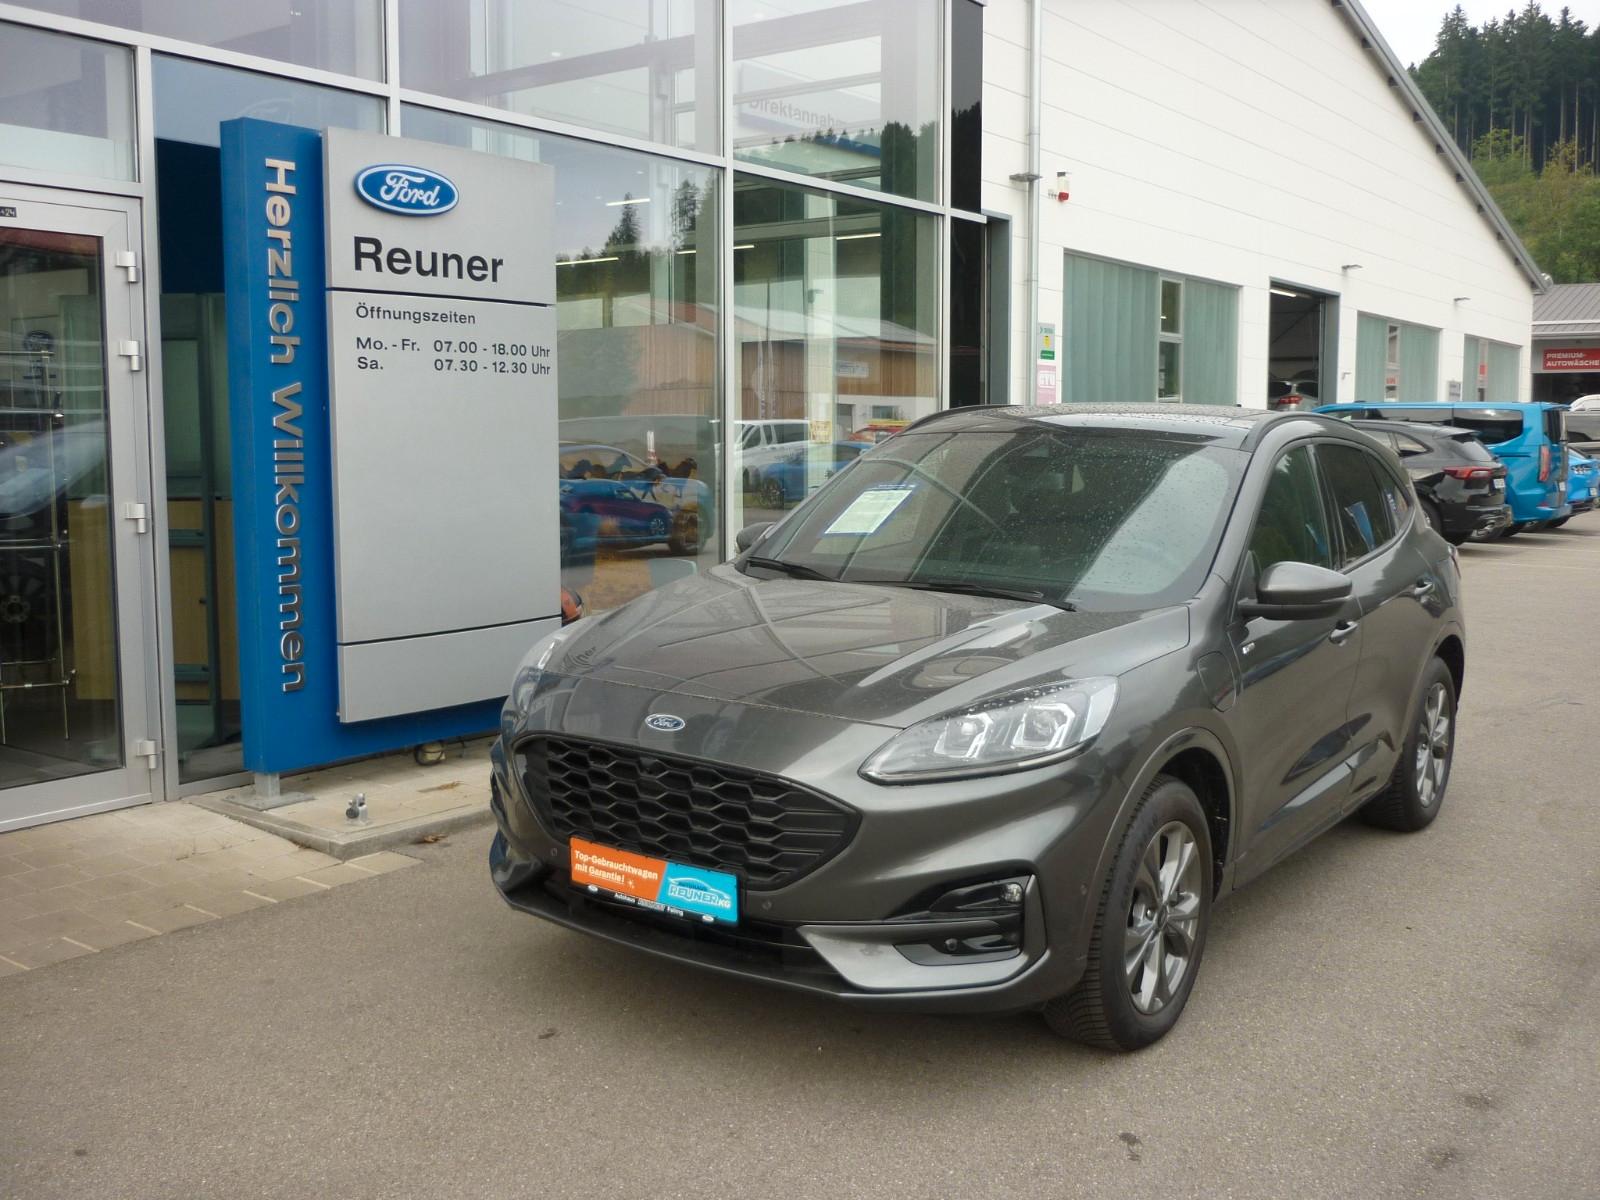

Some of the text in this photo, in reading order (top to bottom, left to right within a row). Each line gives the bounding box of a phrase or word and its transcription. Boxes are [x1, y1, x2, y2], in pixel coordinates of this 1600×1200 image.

[380, 171, 441, 207] Ford
[353, 236, 504, 283] Reuner
[355, 302, 476, 325] Öffnungszeiten
[433, 340, 478, 354] 07.00
[491, 343, 527, 357] 18.00
[531, 345, 551, 358] Uhr
[357, 357, 384, 370] Sa.
[433, 359, 478, 373] 07.30
[491, 361, 528, 375] 12.30
[531, 363, 551, 375] Uhr
[1546, 359, 1600, 367] AUTOWÄSCHE
[264, 158, 305, 692] Herzlich Willkommen
[574, 850, 659, 881] Top-Gebrauchtwagen
[575, 862, 625, 883] mit Garantie!
